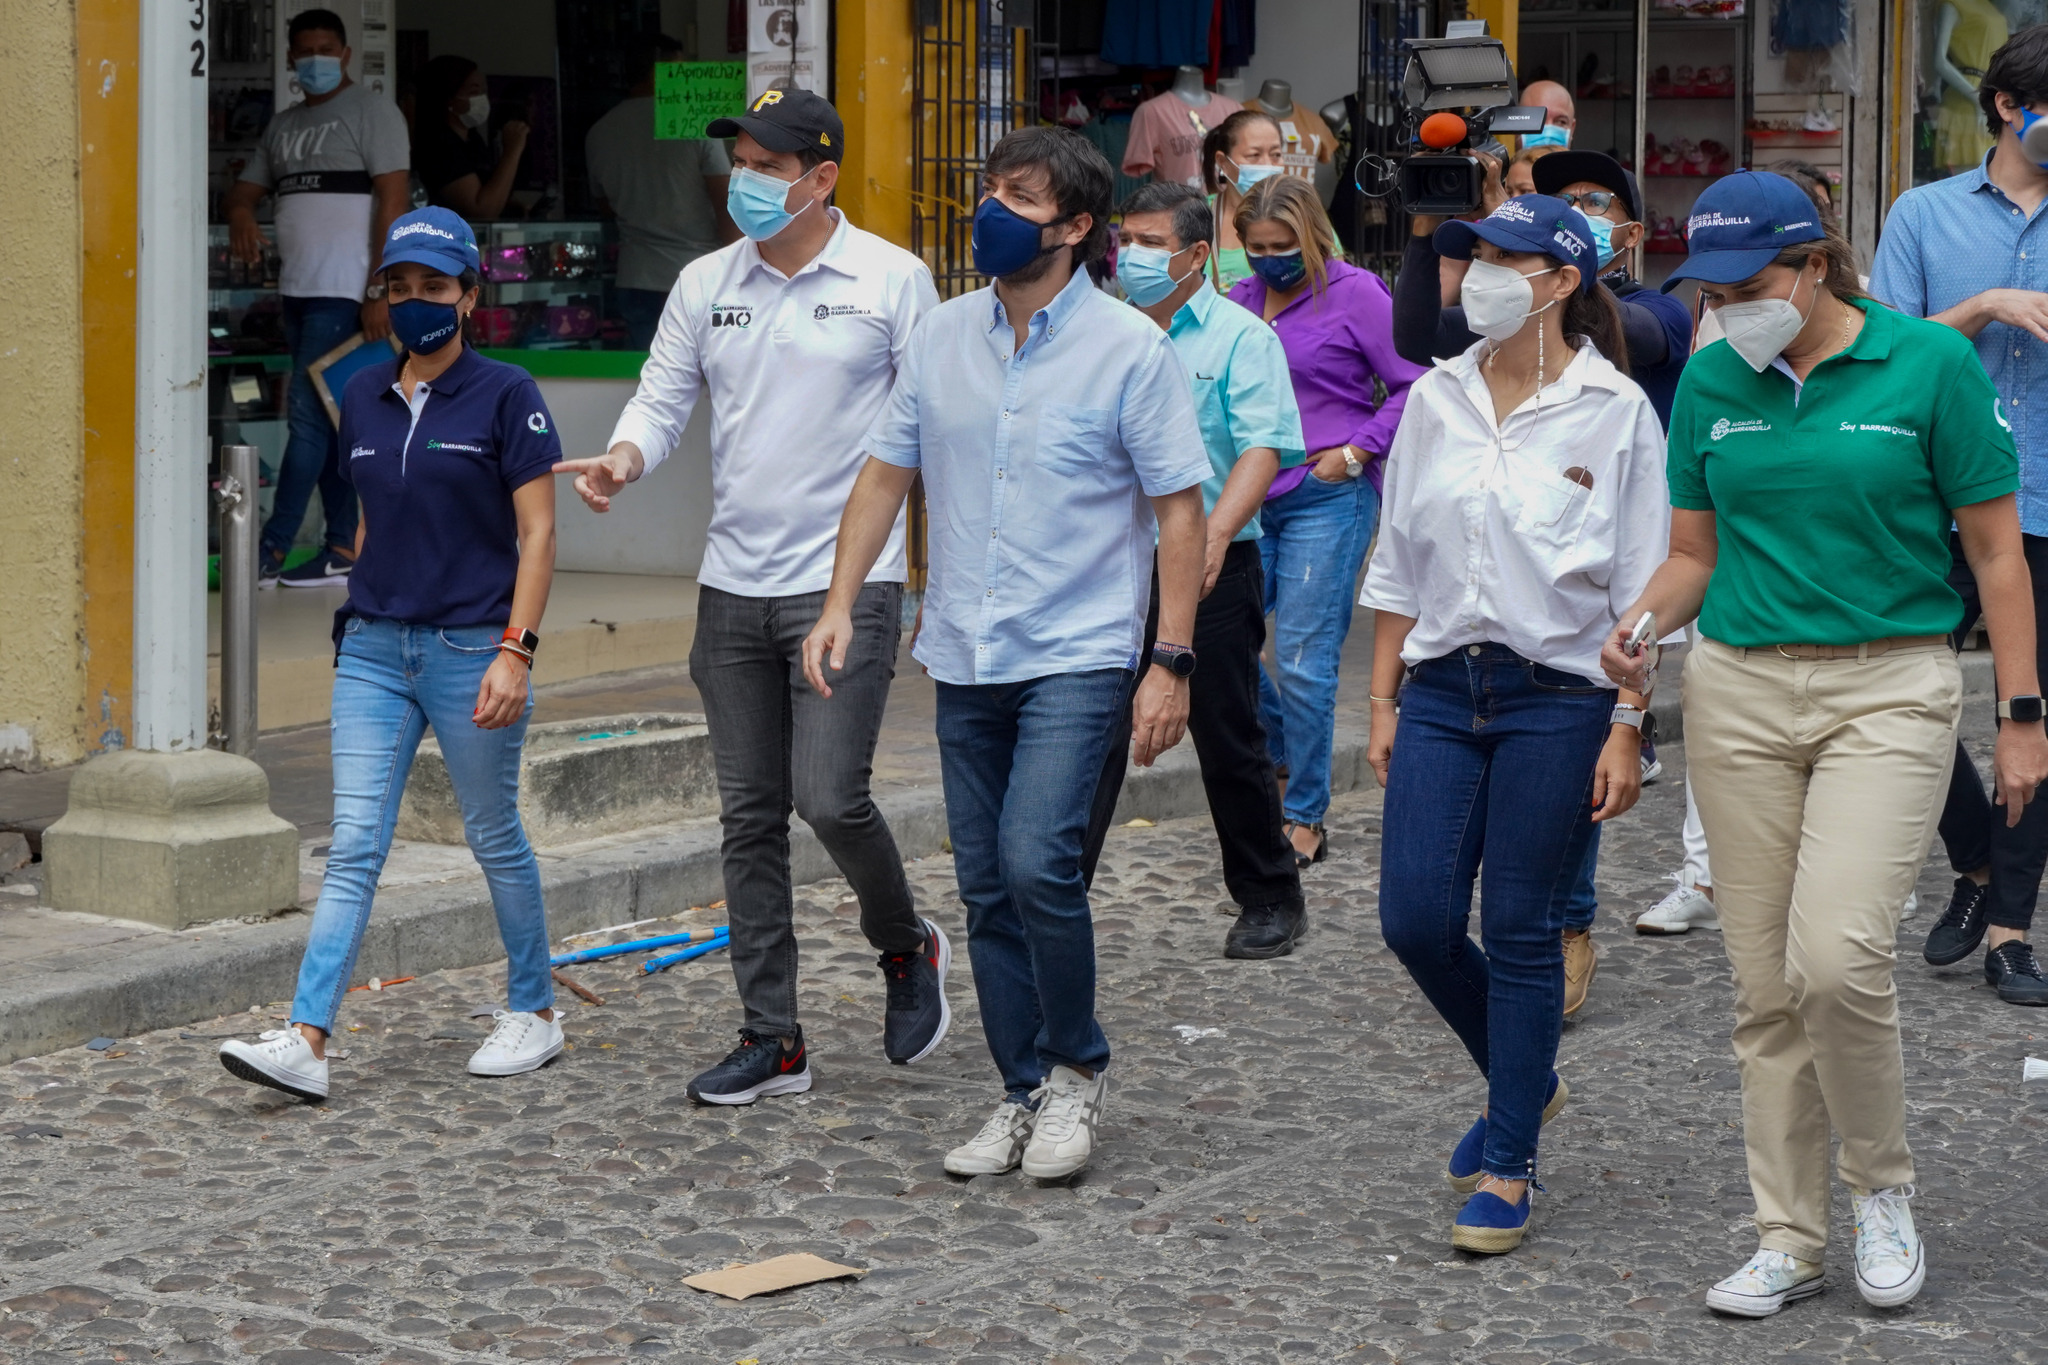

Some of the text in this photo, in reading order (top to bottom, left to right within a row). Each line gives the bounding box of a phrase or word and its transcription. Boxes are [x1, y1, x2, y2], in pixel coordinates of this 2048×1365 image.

[753, 90, 784, 112] P
[275, 121, 339, 164] NOT
[711, 312, 752, 329] BAQ
[1729, 424, 1772, 433] BARRANQUILLA
[1839, 421, 1857, 433] Soy
[427, 439, 441, 451] Soy
